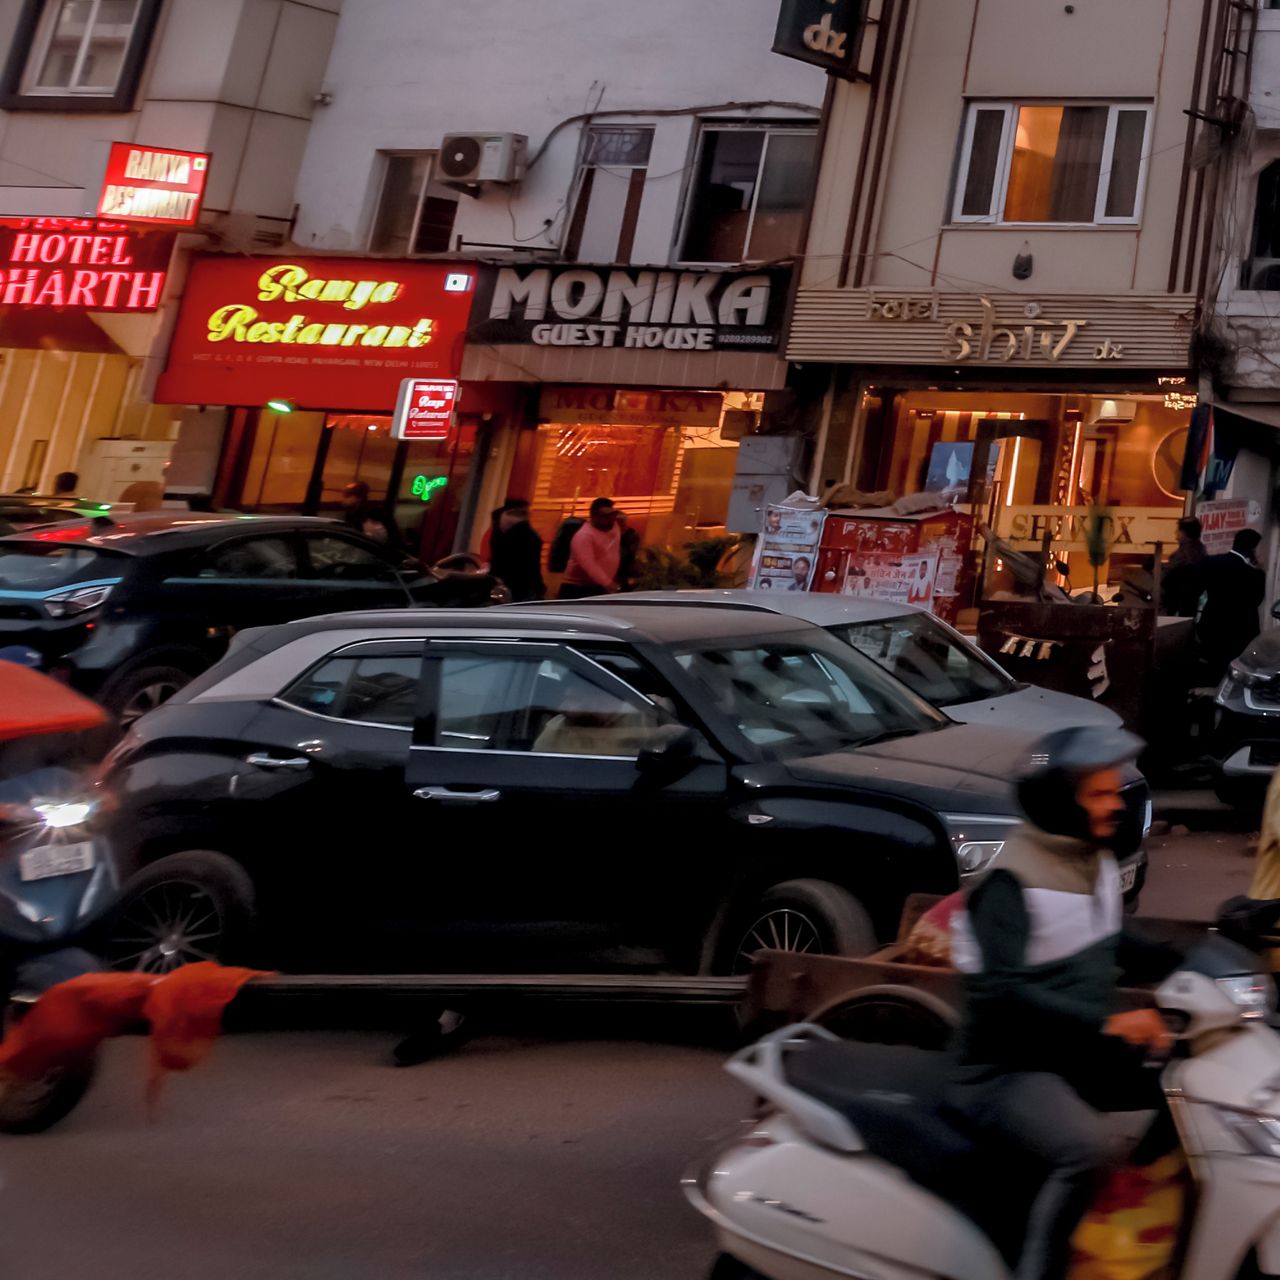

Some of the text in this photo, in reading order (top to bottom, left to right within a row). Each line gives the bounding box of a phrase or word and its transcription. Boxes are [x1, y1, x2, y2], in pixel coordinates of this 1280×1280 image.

[9, 233, 134, 265] HOTEL
[0, 269, 165, 308] HARTH
[257, 264, 402, 311] Ramya
[489, 268, 771, 326] MONIKA
[867, 288, 939, 321] hotel
[207, 304, 433, 347] Restaurant
[532, 323, 716, 350] GUEST HOUSE
[1093, 338, 1124, 360] dx
[555, 391, 709, 413] MOKA
